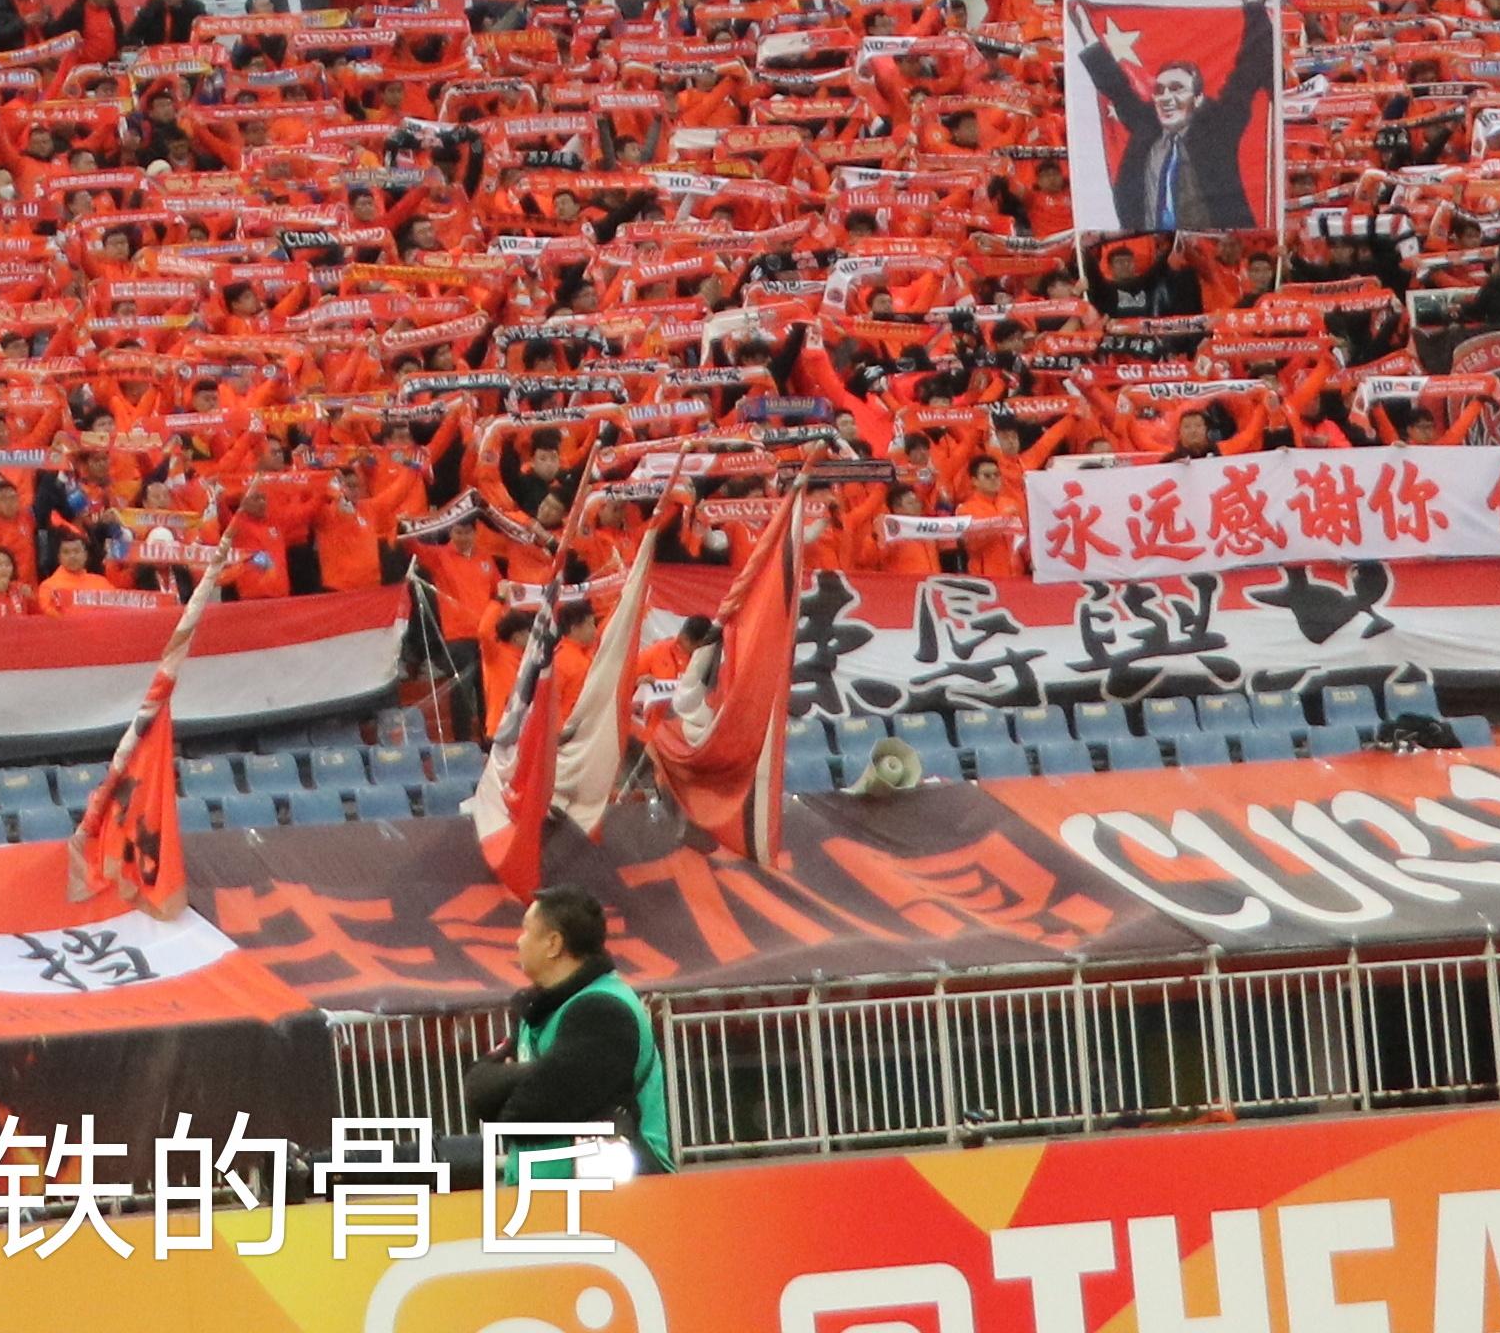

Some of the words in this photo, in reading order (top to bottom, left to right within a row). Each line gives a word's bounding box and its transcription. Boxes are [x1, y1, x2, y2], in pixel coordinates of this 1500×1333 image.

[1116, 365, 1143, 379] GO
[1147, 364, 1188, 379] ASIA
[705, 501, 768, 519] CURVA
[1043, 459, 1450, 563] 永远感谢你
